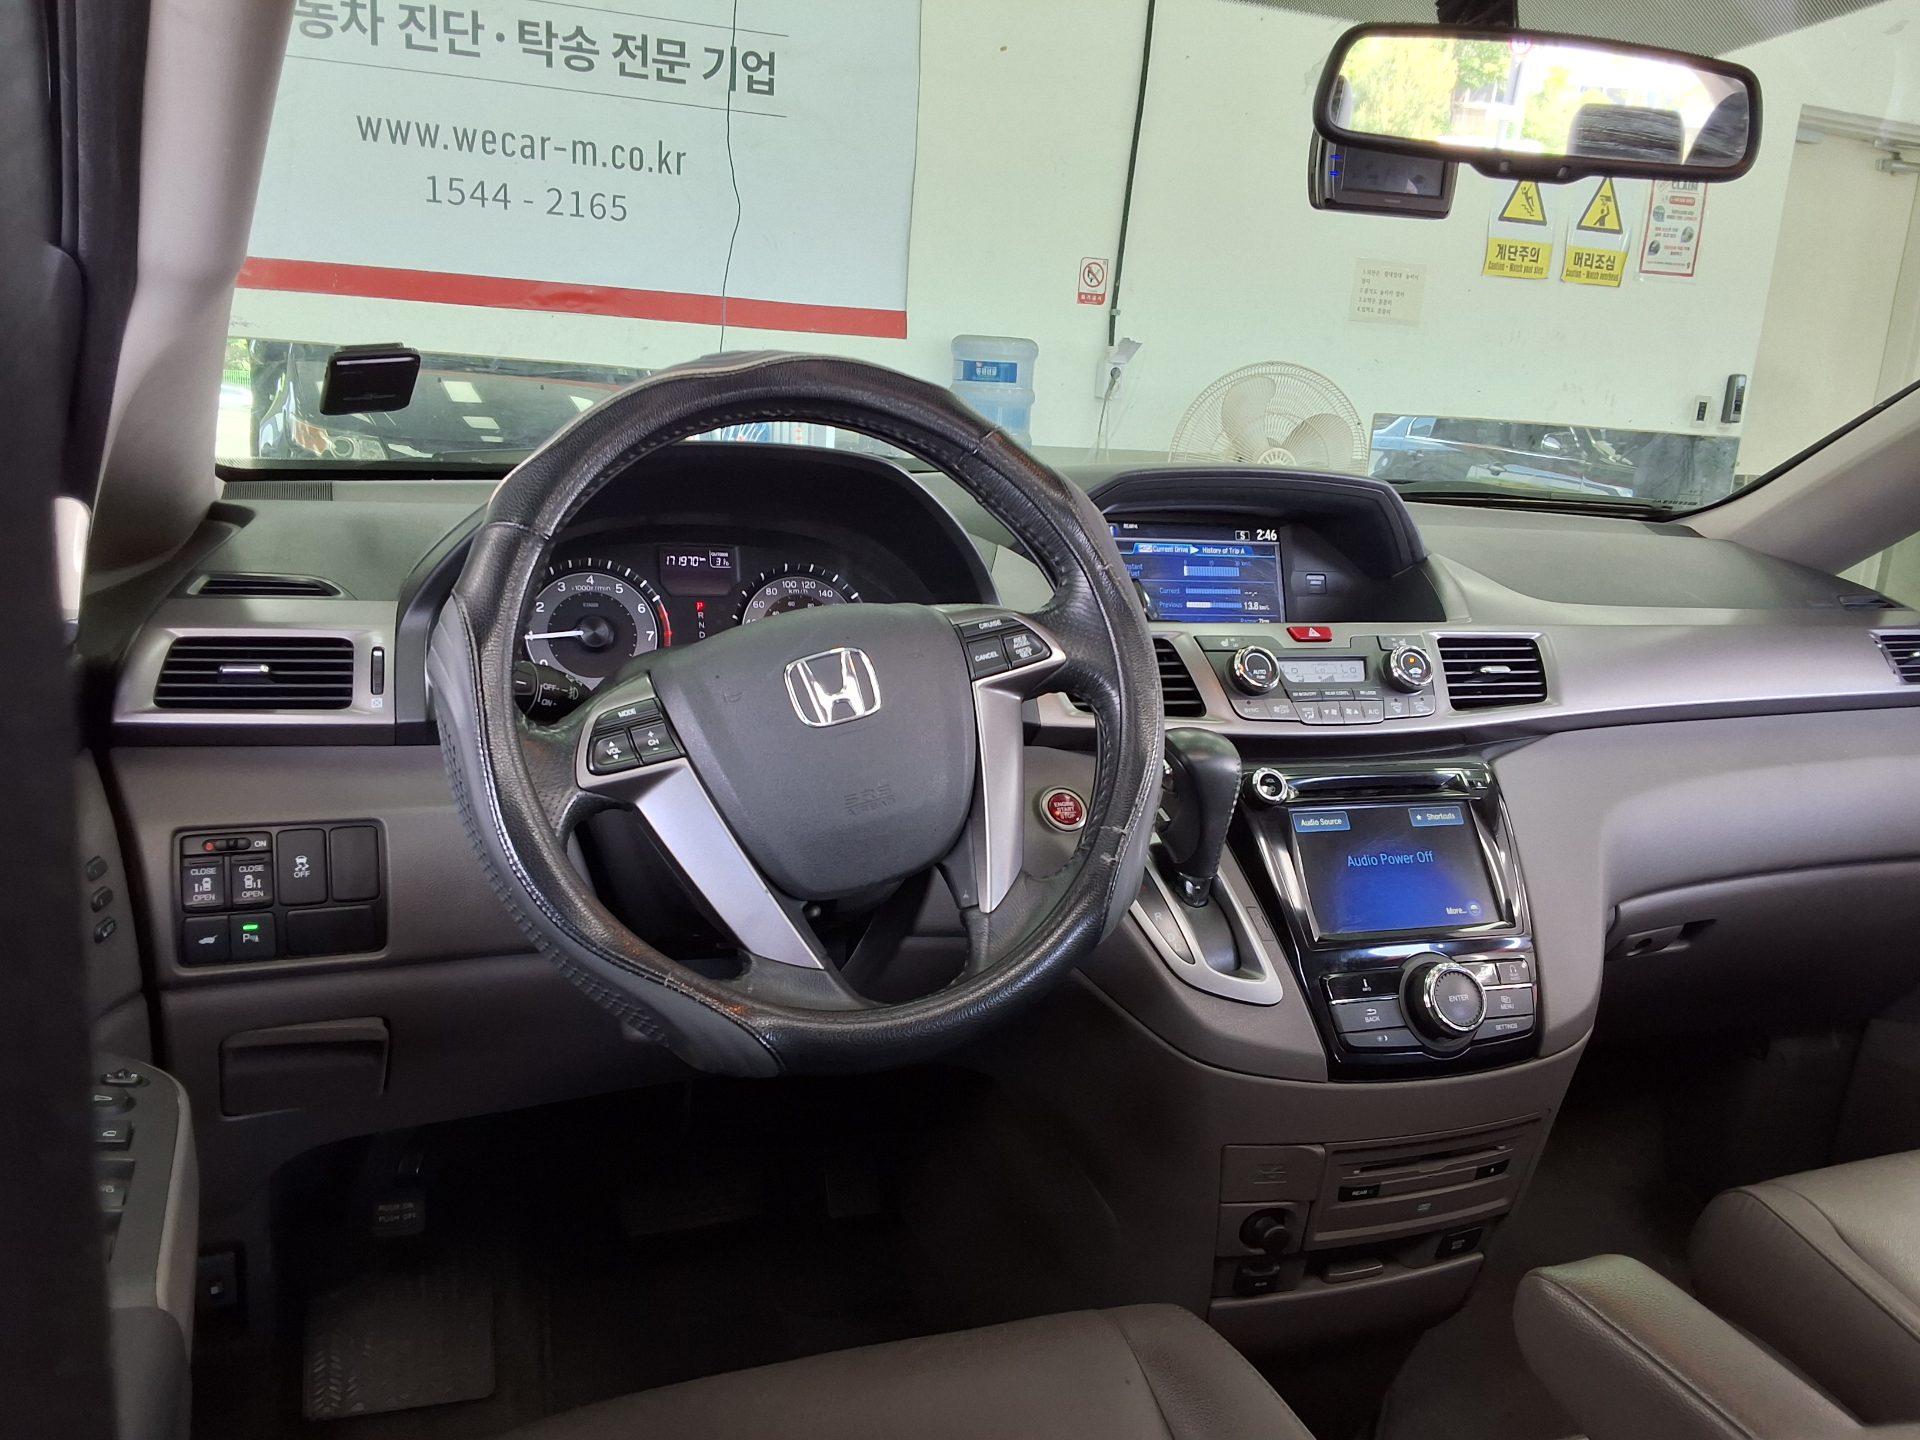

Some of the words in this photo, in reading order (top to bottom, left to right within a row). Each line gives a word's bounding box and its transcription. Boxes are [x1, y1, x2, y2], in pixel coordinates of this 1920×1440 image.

[294, 0, 385, 46] 동차
[611, 31, 690, 85] 전문
[702, 44, 777, 97] 기업
[356, 113, 687, 177] www.wecar-m.co.kr
[425, 174, 512, 211] 1544
[546, 187, 628, 222] 2165
[1495, 243, 1541, 264] 계단주의
[1573, 251, 1617, 271] 머리조심
[1256, 529, 1278, 541] 2:46
[1152, 545, 1174, 553] Current
[1202, 546, 1220, 555] History
[1229, 547, 1240, 555] Trip
[782, 580, 797, 589] 100
[801, 581, 816, 589] 120
[765, 587, 778, 596] 80
[818, 590, 833, 598] 140
[696, 602, 703, 610] P
[752, 600, 765, 609] 60
[1243, 601, 1259, 611] 13.8
[698, 611, 704, 619] R
[978, 619, 1002, 630] CRUISE
[698, 631, 706, 639] D
[974, 651, 999, 662] CANCEL
[542, 682, 557, 692] OFF
[617, 708, 637, 718] MODE
[606, 747, 622, 756] VOL
[1426, 812, 1456, 821] Shortcuts
[1301, 818, 1319, 827] Audio
[1320, 817, 1342, 826] Source
[254, 840, 267, 848] ON
[1347, 854, 1378, 867] Audio
[1380, 853, 1414, 865] Power
[1417, 850, 1434, 863] Off
[190, 867, 217, 876] CLOSE
[238, 864, 265, 873] CLOSE
[293, 871, 311, 879] OFF
[192, 893, 216, 902] OPEN
[241, 889, 264, 899] OPEN
[1448, 994, 1469, 1003] ENTER
[1495, 1023, 1518, 1031] SETTINGS
